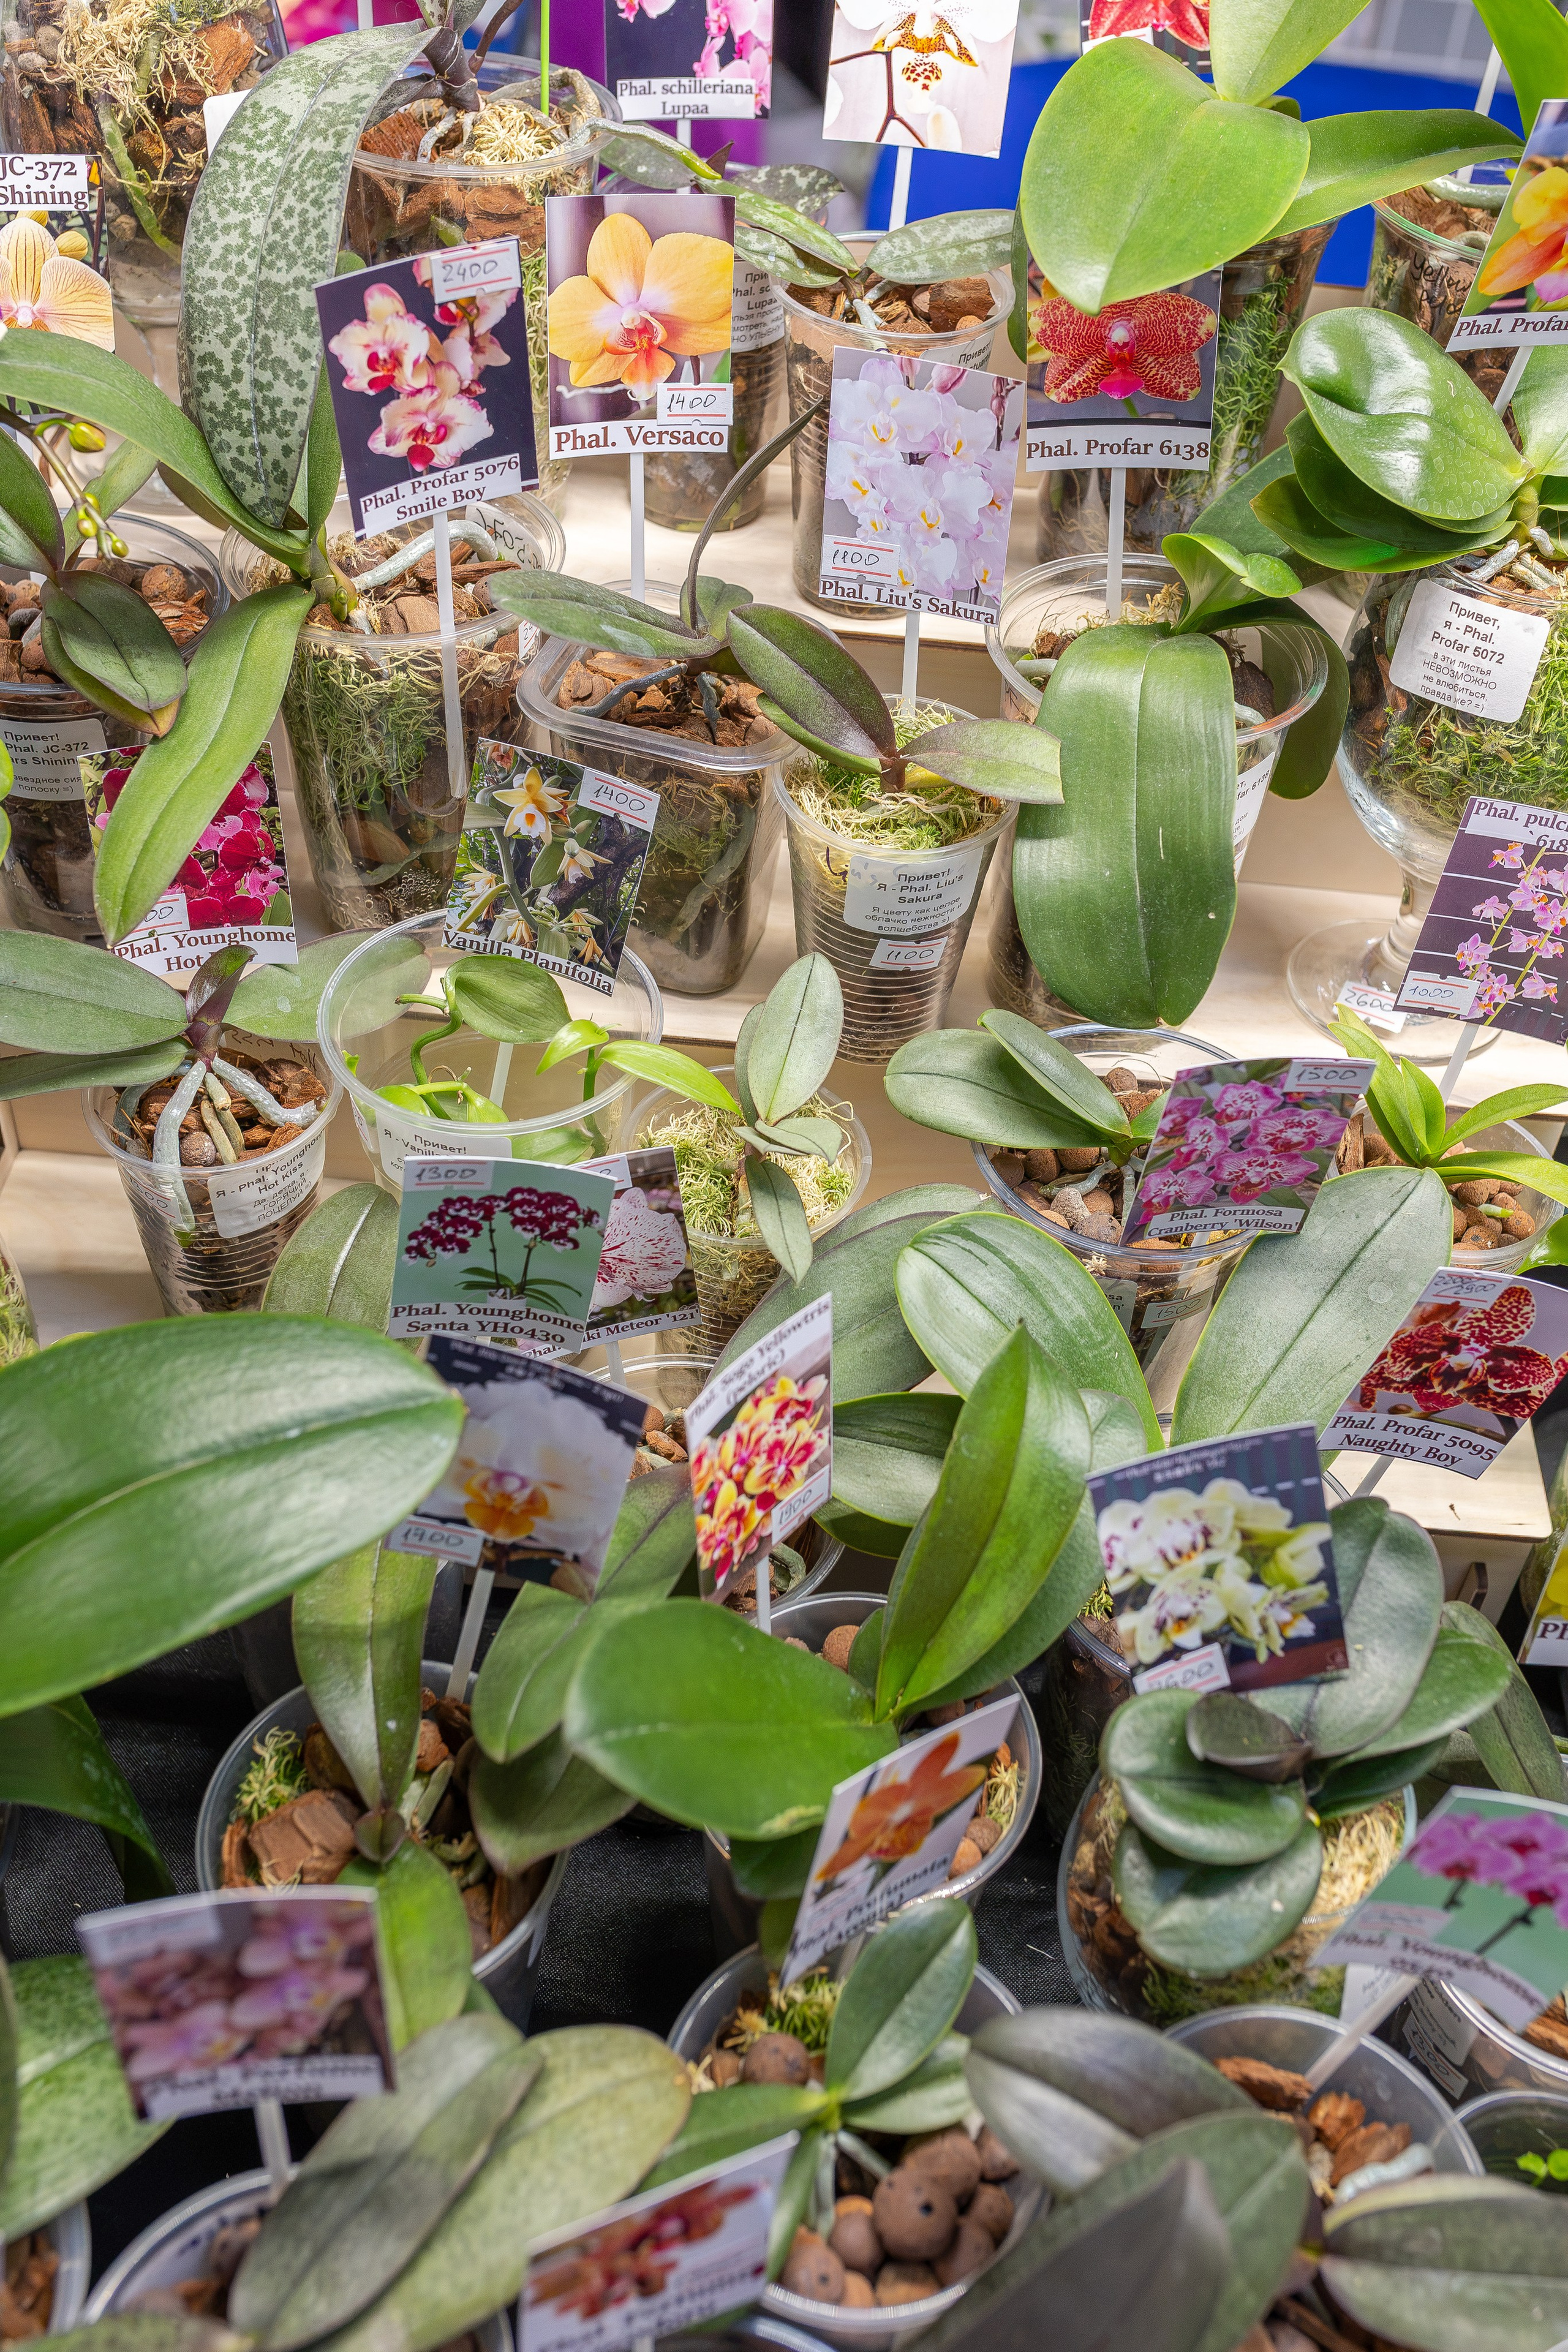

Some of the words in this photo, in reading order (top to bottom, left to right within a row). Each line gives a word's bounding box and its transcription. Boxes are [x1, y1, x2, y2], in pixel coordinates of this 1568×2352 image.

[619, 81, 656, 96] Phal.
[662, 80, 753, 94] schilleriana
[662, 102, 709, 118] Lupaa
[0, 156, 77, 181] JC-372
[0, 184, 88, 209] Shining
[442, 260, 498, 283] 2400
[733, 287, 755, 298] hal.
[1454, 317, 1503, 337] Phal.
[667, 393, 716, 412] 1400
[554, 426, 616, 452] Phal.
[624, 426, 724, 446] Versaco
[1027, 439, 1078, 458] Phal.
[1085, 437, 1153, 455] Profar
[1160, 439, 1209, 460] 6138
[363, 486, 406, 513] Phal.
[411, 470, 469, 495] Profar
[475, 456, 519, 481] 5076
[397, 495, 448, 520] Smile
[453, 486, 486, 502] Boy
[832, 549, 880, 566] 1100
[820, 581, 869, 601] Phal.
[875, 587, 922, 609] Liu's
[927, 598, 996, 624] Sakura
[1449, 601, 1500, 630] Привет,
[1463, 625, 1494, 644] Phal.
[1431, 631, 1469, 654] Profar
[1472, 646, 1505, 665] 5072
[1423, 659, 1497, 690] НЕВОЗМОЖНО
[1441, 655, 1456, 666] эти
[1458, 661, 1491, 677] листья
[1423, 674, 1434, 683] не
[1420, 685, 1452, 703] правда
[4, 731, 59, 742] Привет!
[43, 742, 89, 753] JC-372
[32, 757, 78, 766] Shinin
[18, 784, 59, 794] полоску
[594, 785, 645, 811] 1400
[1473, 801, 1519, 821] Phal.
[1523, 814, 1568, 832] pulc
[898, 869, 950, 883] Привет!
[900, 884, 931, 893] Phal.
[937, 874, 964, 889] Liu's
[883, 909, 911, 918] цвету
[933, 897, 960, 913] целое
[898, 893, 942, 903] Sakura
[865, 914, 908, 925] облачко
[911, 908, 955, 924] нежности
[116, 937, 167, 959] Phal.
[173, 927, 296, 949] Younghome
[165, 953, 203, 972] Hot
[444, 930, 513, 957] Vanilla
[521, 949, 612, 993] Planifolia
[887, 950, 934, 960] 1100
[1295, 1068, 1357, 1081] 1500
[402, 1138, 441, 1156] Vanill
[414, 1134, 467, 1155] Привет!
[239, 1175, 270, 1193] Phal.
[271, 1129, 325, 1175] Younghom
[258, 1179, 280, 1194] Hot
[282, 1161, 304, 1182] Kiss
[415, 1165, 476, 1182] 1300
[263, 1178, 306, 1210] ГОРЯЧИЙ
[258, 1189, 303, 1221] ПОЦЕЛУЙ
[1169, 1210, 1207, 1223] Phal.
[1212, 1208, 1283, 1217] Formosa
[1148, 1222, 1229, 1237] Cranberry
[392, 1303, 447, 1318] Phal.
[454, 1303, 584, 1333] Younghome
[1157, 1298, 1201, 1318] 1500
[406, 1320, 470, 1333] Santa
[606, 1317, 662, 1336] Meteor
[1330, 1416, 1376, 1430] Phal.
[1381, 1419, 1445, 1441] Profar
[1444, 1435, 1497, 1461] 5095
[1338, 1434, 1422, 1458] Naughty
[1422, 1446, 1463, 1468] Boy
